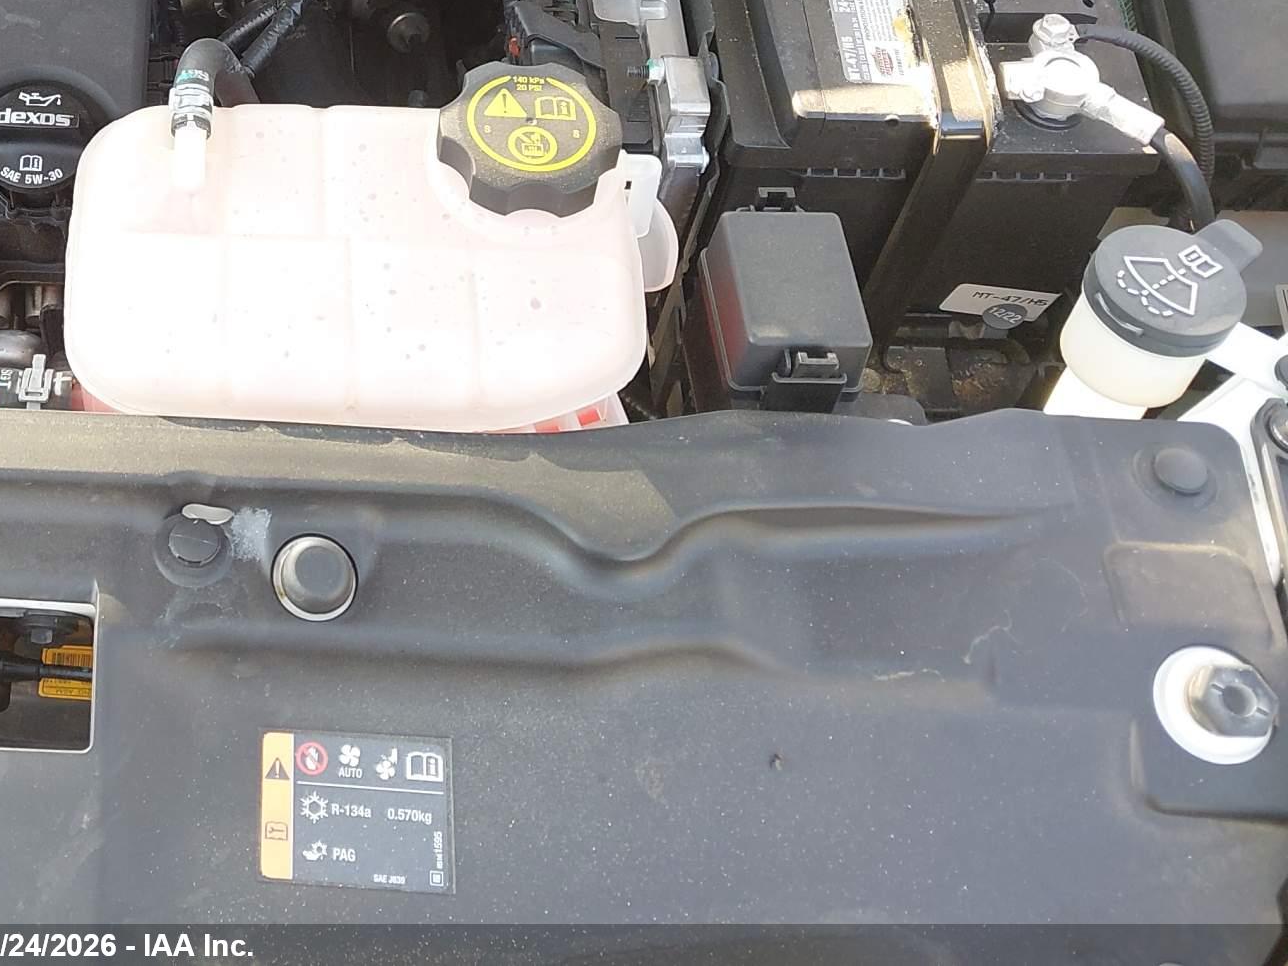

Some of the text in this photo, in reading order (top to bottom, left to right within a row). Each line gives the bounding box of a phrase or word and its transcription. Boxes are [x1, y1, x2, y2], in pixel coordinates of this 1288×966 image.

[513, 76, 545, 84] 140 kPa
[0, 167, 64, 185] SAE 5W-30
[972, 291, 1048, 307] MT-47/H5
[987, 306, 1023, 324] 12/22
[338, 767, 363, 779] AUTO
[331, 802, 433, 825] R-134a 0.570kg
[332, 848, 357, 862] PAG
